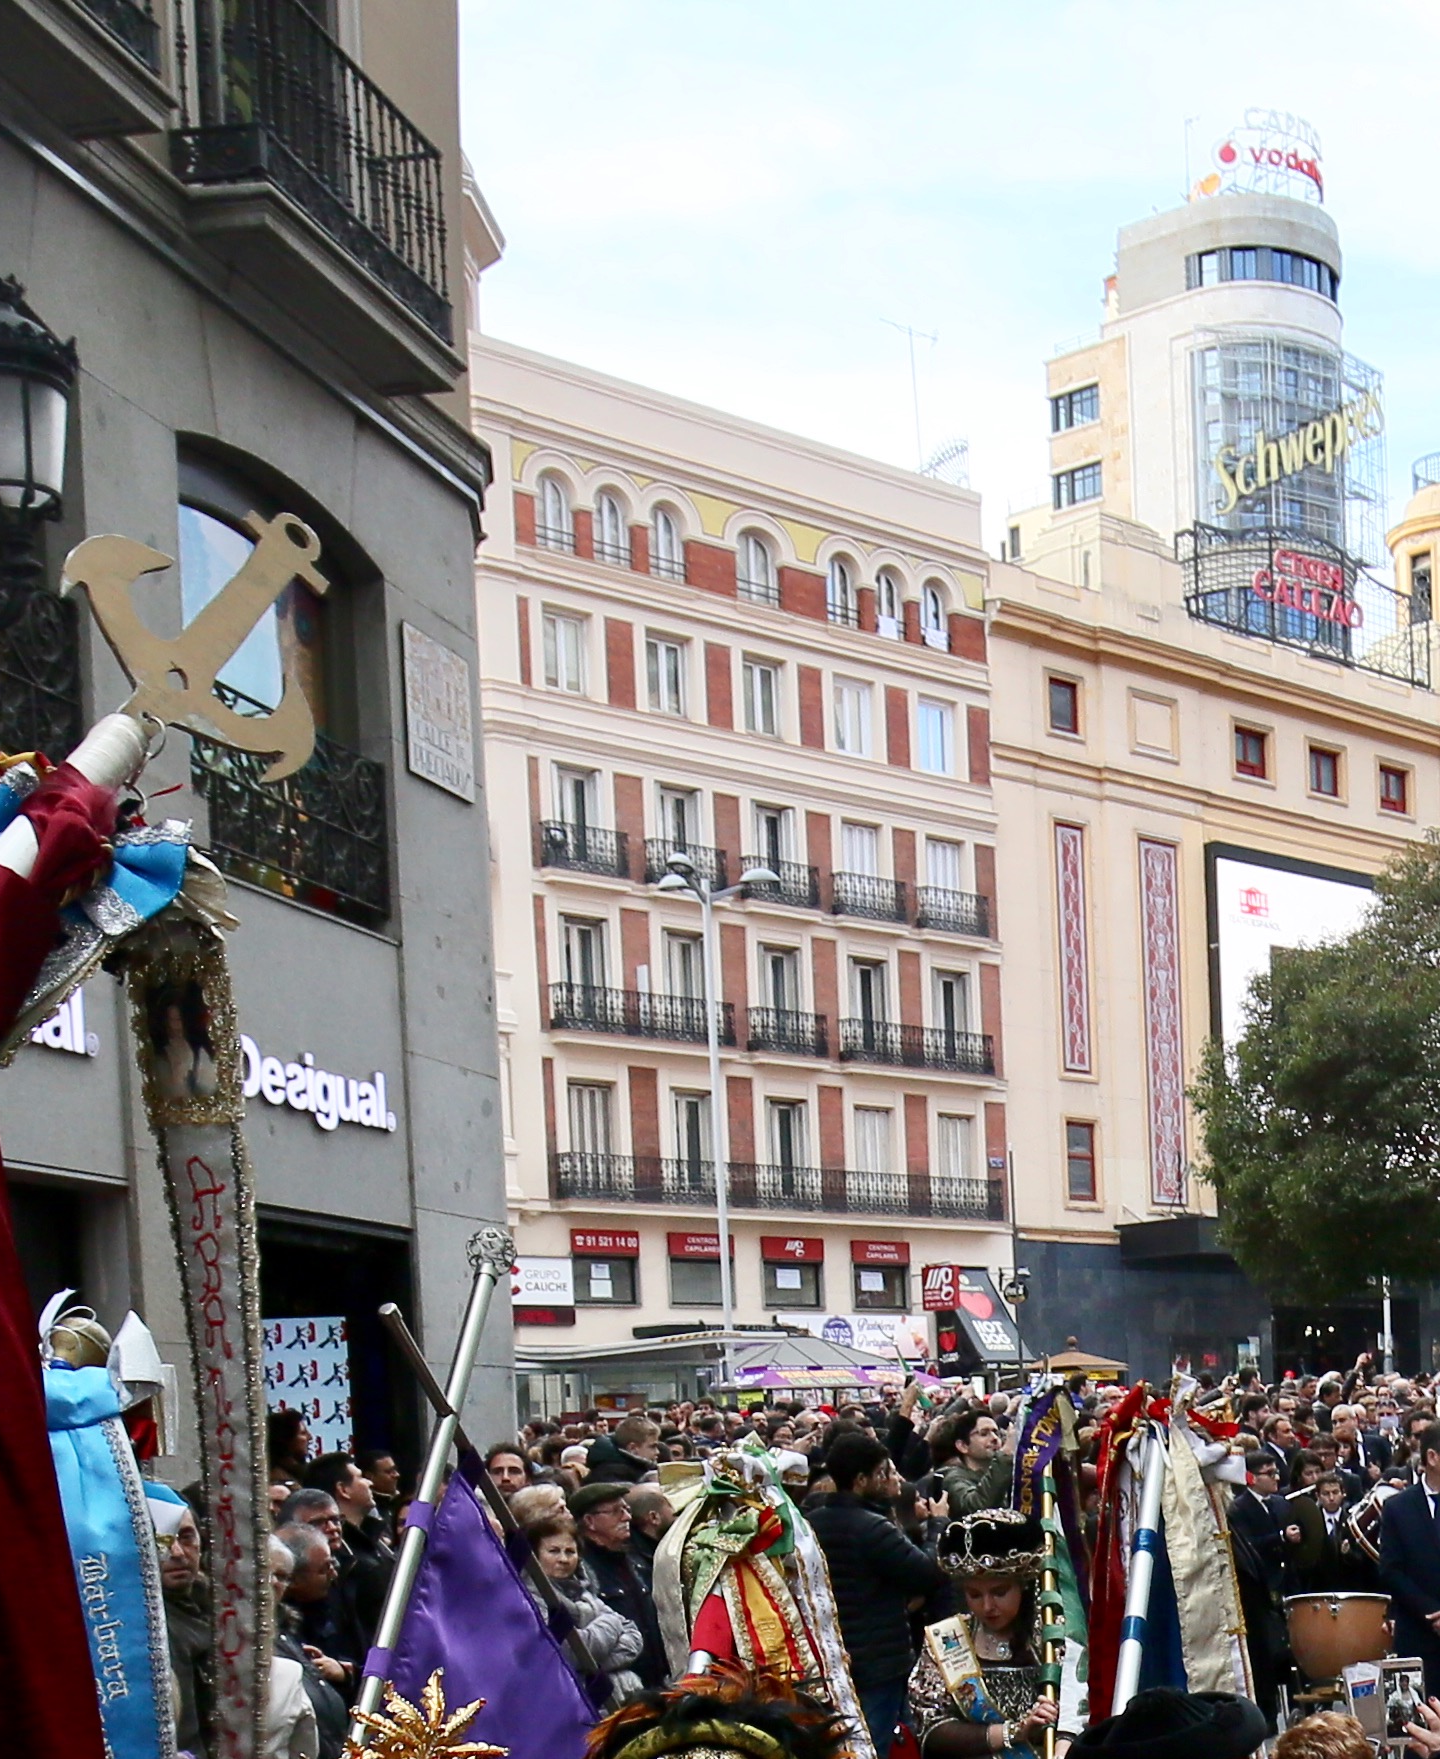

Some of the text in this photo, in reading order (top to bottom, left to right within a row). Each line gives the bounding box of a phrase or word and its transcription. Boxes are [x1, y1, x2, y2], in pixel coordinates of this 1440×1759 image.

[1211, 383, 1386, 515] Schweppes
[1273, 547, 1345, 592] CINES
[1251, 568, 1364, 630] CALLAO
[585, 1236, 638, 1248] 91 521 14 00
[524, 1269, 561, 1280] GRUPO
[525, 1281, 568, 1292] CALICHE
[972, 1320, 1003, 1333] HOT
[980, 1333, 1011, 1345] DOG
